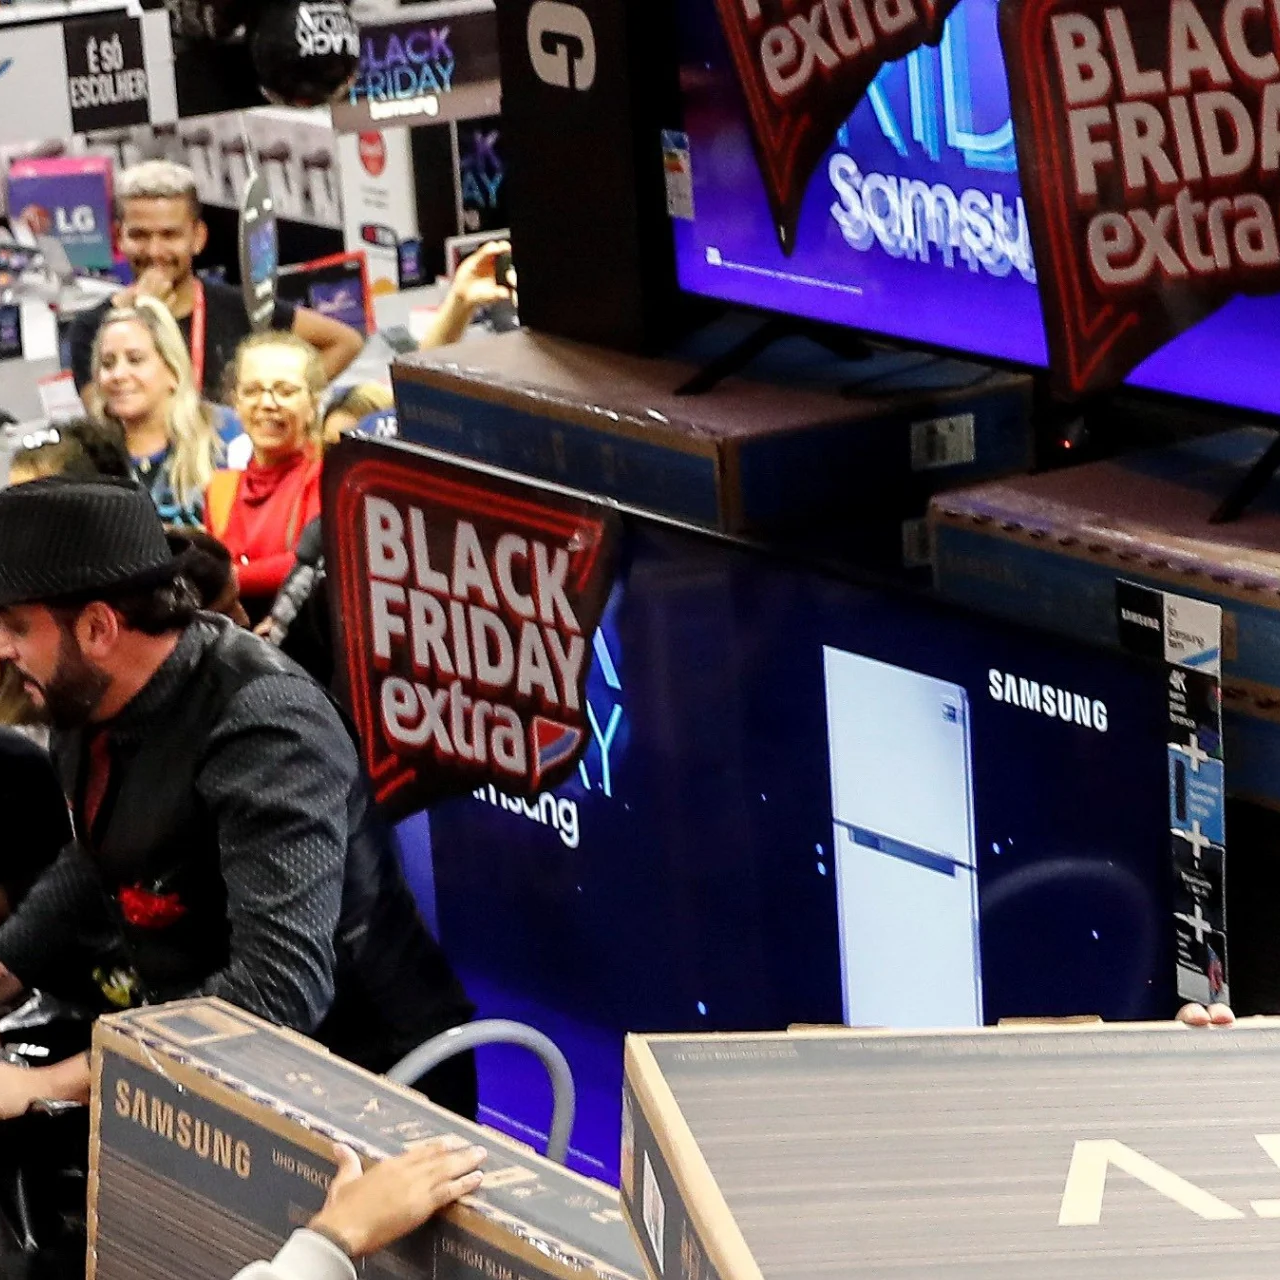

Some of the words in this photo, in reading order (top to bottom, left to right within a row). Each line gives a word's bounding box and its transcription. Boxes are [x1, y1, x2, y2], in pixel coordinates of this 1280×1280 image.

[55, 204, 95, 233] LG
[1086, 188, 1280, 287] extra
[363, 494, 581, 630] BLACK
[369, 580, 587, 712] FRIDAY
[380, 672, 527, 774] extra
[987, 667, 1109, 733] SAMSUNG
[113, 1077, 254, 1182] SAMSUNG
[271, 1148, 299, 1176] UHD
[441, 1236, 485, 1271] DESIGN
